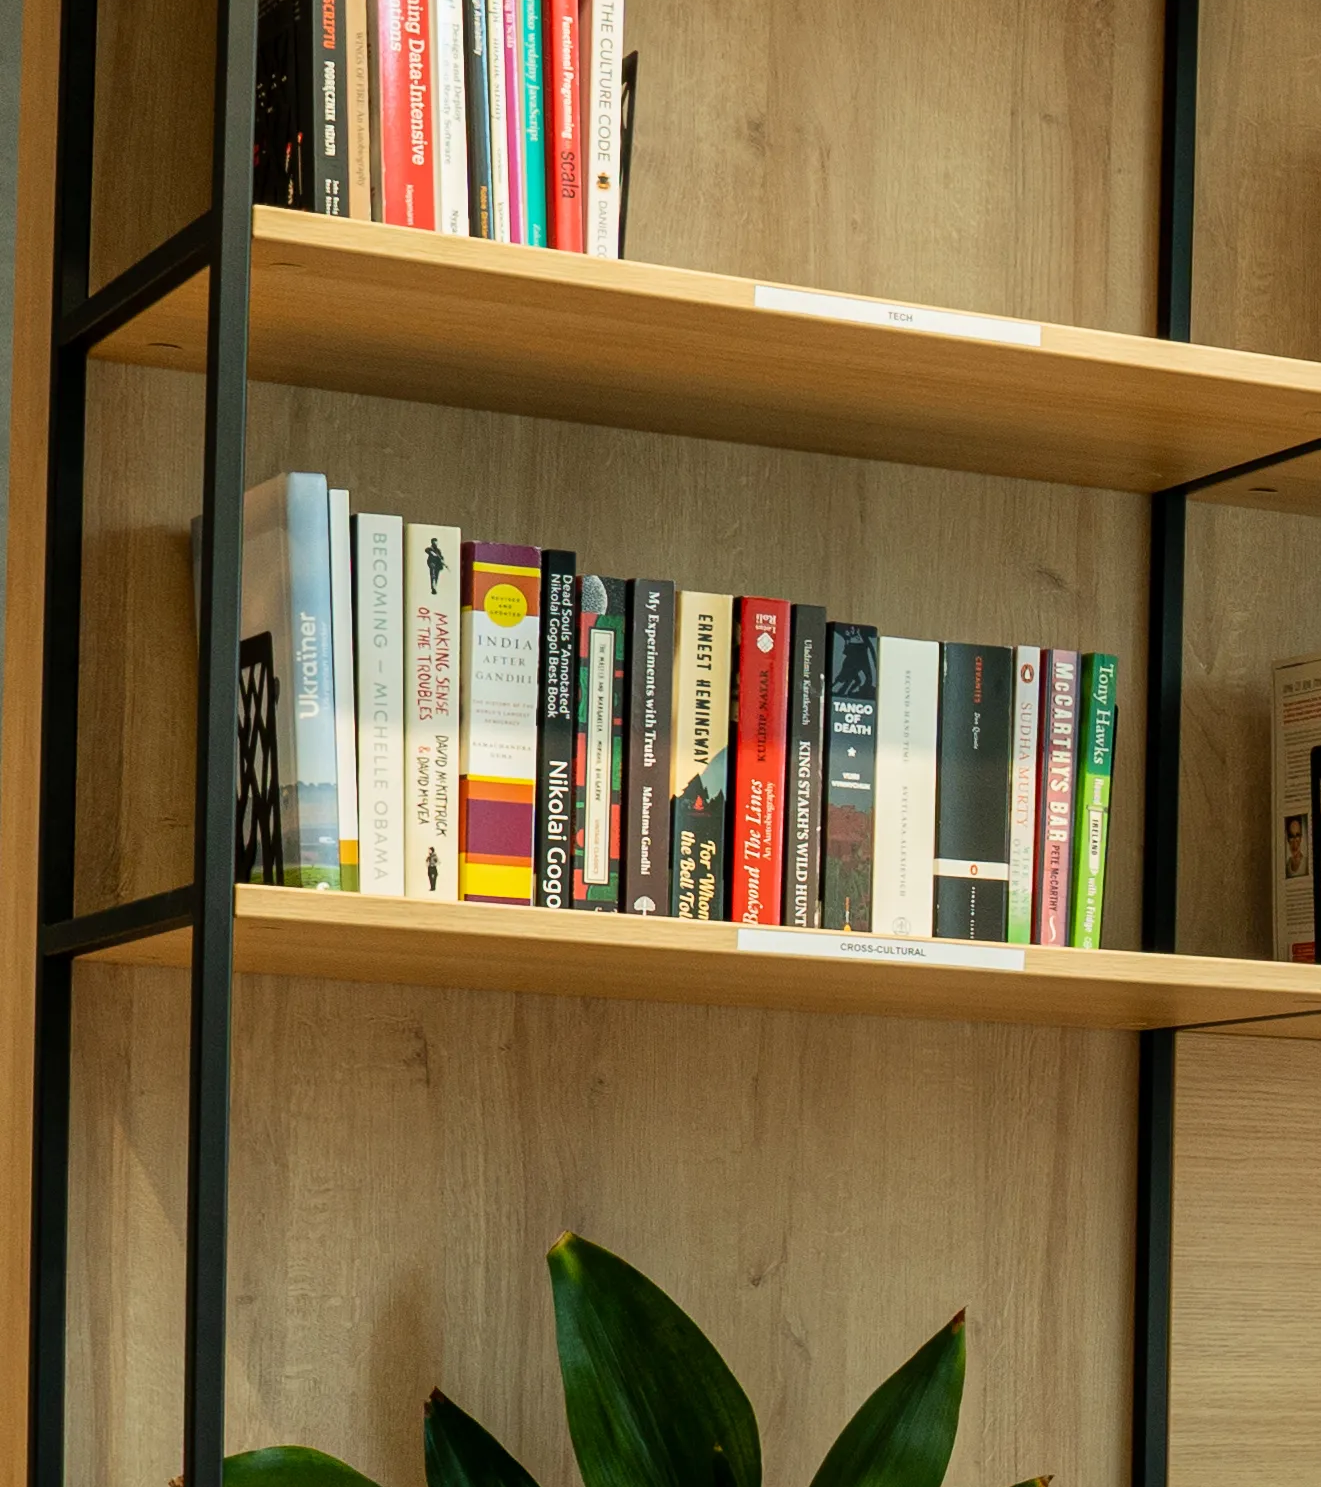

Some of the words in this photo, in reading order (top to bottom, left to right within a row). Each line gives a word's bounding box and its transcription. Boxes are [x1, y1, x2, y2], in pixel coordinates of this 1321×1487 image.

[599, 1, 615, 34] THE
[561, 16, 574, 71] Functional
[356, 67, 365, 82] OF
[598, 37, 614, 110] CULTURE
[408, 38, 428, 166] Data-Intensive
[526, 84, 540, 142] JavaScript
[560, 72, 574, 140] Programming
[597, 113, 612, 162] CODE
[560, 151, 579, 199] scala
[597, 200, 608, 240] DANIEL
[888, 311, 913, 322] TECH
[373, 532, 388, 649] BECOMING
[549, 573, 561, 615] Nikolai
[562, 574, 573, 606] Dead
[644, 591, 660, 611] My
[416, 606, 431, 622] OF
[561, 609, 572, 641] Souls
[416, 627, 431, 650] THE
[433, 612, 451, 671] MAKING
[478, 635, 532, 650] INDIA
[547, 618, 560, 654] Gogol
[644, 613, 660, 697] Experiments
[696, 614, 713, 671] ERNEST
[476, 671, 532, 684] GANDHI
[483, 655, 525, 666] AFTER
[548, 657, 559, 683] Best
[802, 639, 813, 678] Uladzimir
[416, 654, 433, 722] TROUBLES
[435, 675, 451, 717] SENSE
[547, 686, 558, 718] Book
[559, 644, 571, 720] "Annotated"
[758, 670, 770, 712] NAYAR
[801, 678, 812, 726] Karatkevich
[1093, 663, 1115, 705] Tony
[644, 698, 657, 728] with
[693, 679, 711, 765] HEMINGWAY
[833, 701, 873, 715] TANGO
[845, 714, 861, 723] OF
[1049, 662, 1074, 792] McCARTHY'S
[373, 681, 388, 789] MICHELLE
[833, 722, 872, 735] DEATH
[1019, 702, 1033, 761] SUDHA
[1093, 708, 1111, 764] Hawks
[418, 746, 431, 754] &
[434, 735, 450, 767] DAVID
[643, 730, 656, 768] Truth
[798, 740, 811, 778] KING
[416, 756, 431, 787] DAVID
[547, 760, 569, 842] Nikolai
[641, 785, 653, 836] Mahatma
[744, 778, 763, 826] Lines
[796, 779, 810, 840] STAKH'S
[1016, 767, 1031, 829] MURTY
[1092, 778, 1104, 806] Round
[762, 781, 776, 845] Autobiography
[1047, 801, 1069, 842] BAR
[373, 800, 389, 880] OBAMA
[640, 836, 652, 876] Gandhi
[680, 830, 696, 856] the
[699, 840, 716, 871] For
[743, 829, 762, 861] The
[762, 846, 772, 862] An
[1050, 845, 1060, 865] PETE
[1091, 819, 1099, 856] IRELAND
[679, 858, 695, 890] Bell
[795, 842, 809, 882] WILD
[899, 839, 907, 898] ALEXIEVICH
[742, 864, 763, 925] Beyond
[794, 883, 807, 927] HUNT
[1049, 868, 1060, 912] McCARTHY
[1087, 877, 1096, 895] with
[840, 942, 926, 957] CROSS-CULTURAL
